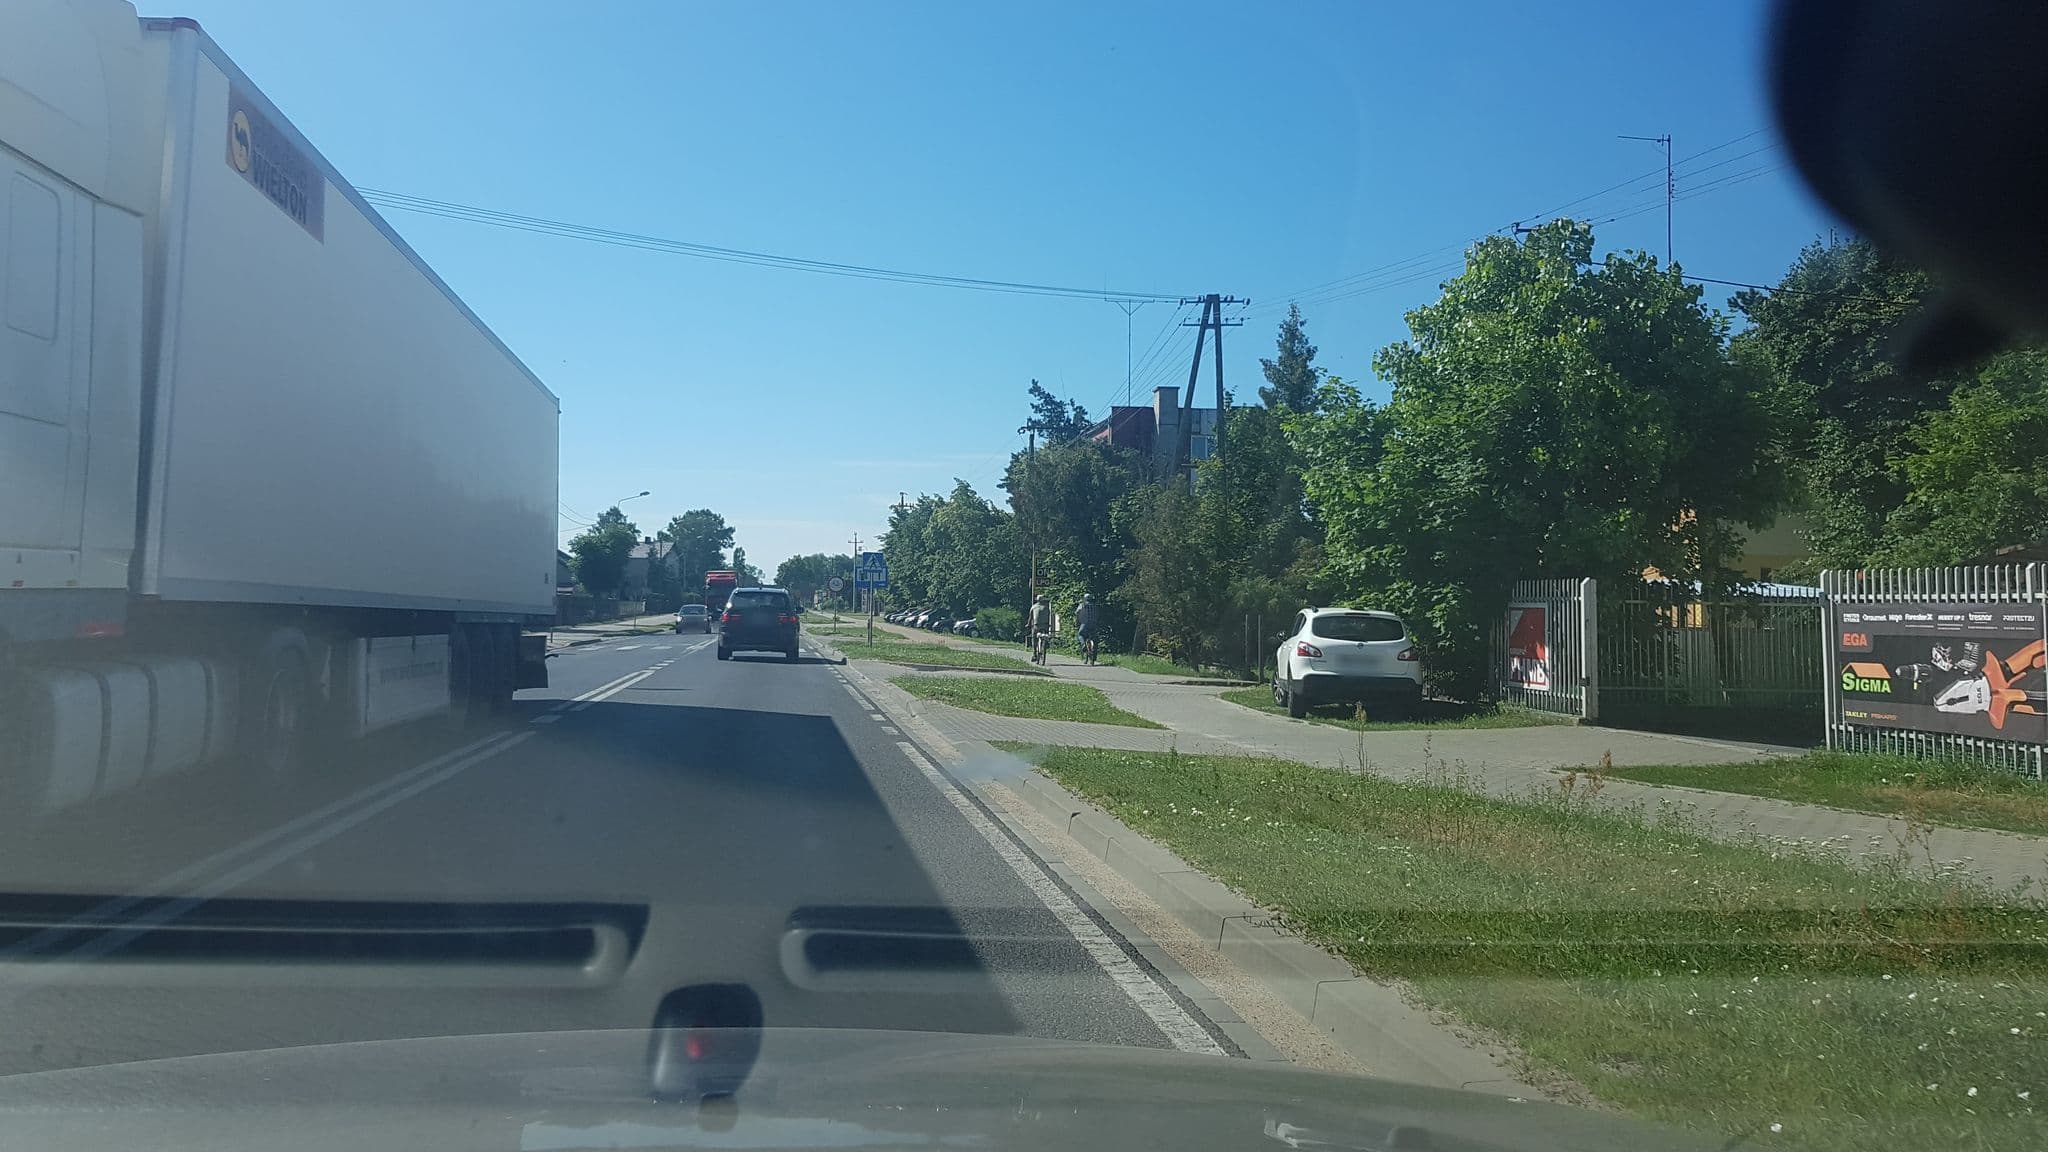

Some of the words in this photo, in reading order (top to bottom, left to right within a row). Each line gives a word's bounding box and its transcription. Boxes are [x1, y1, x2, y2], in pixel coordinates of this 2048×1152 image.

[253, 150, 307, 225] WIELTON
[1842, 633, 1868, 647] EGA
[1842, 672, 1891, 694] SIGMA
